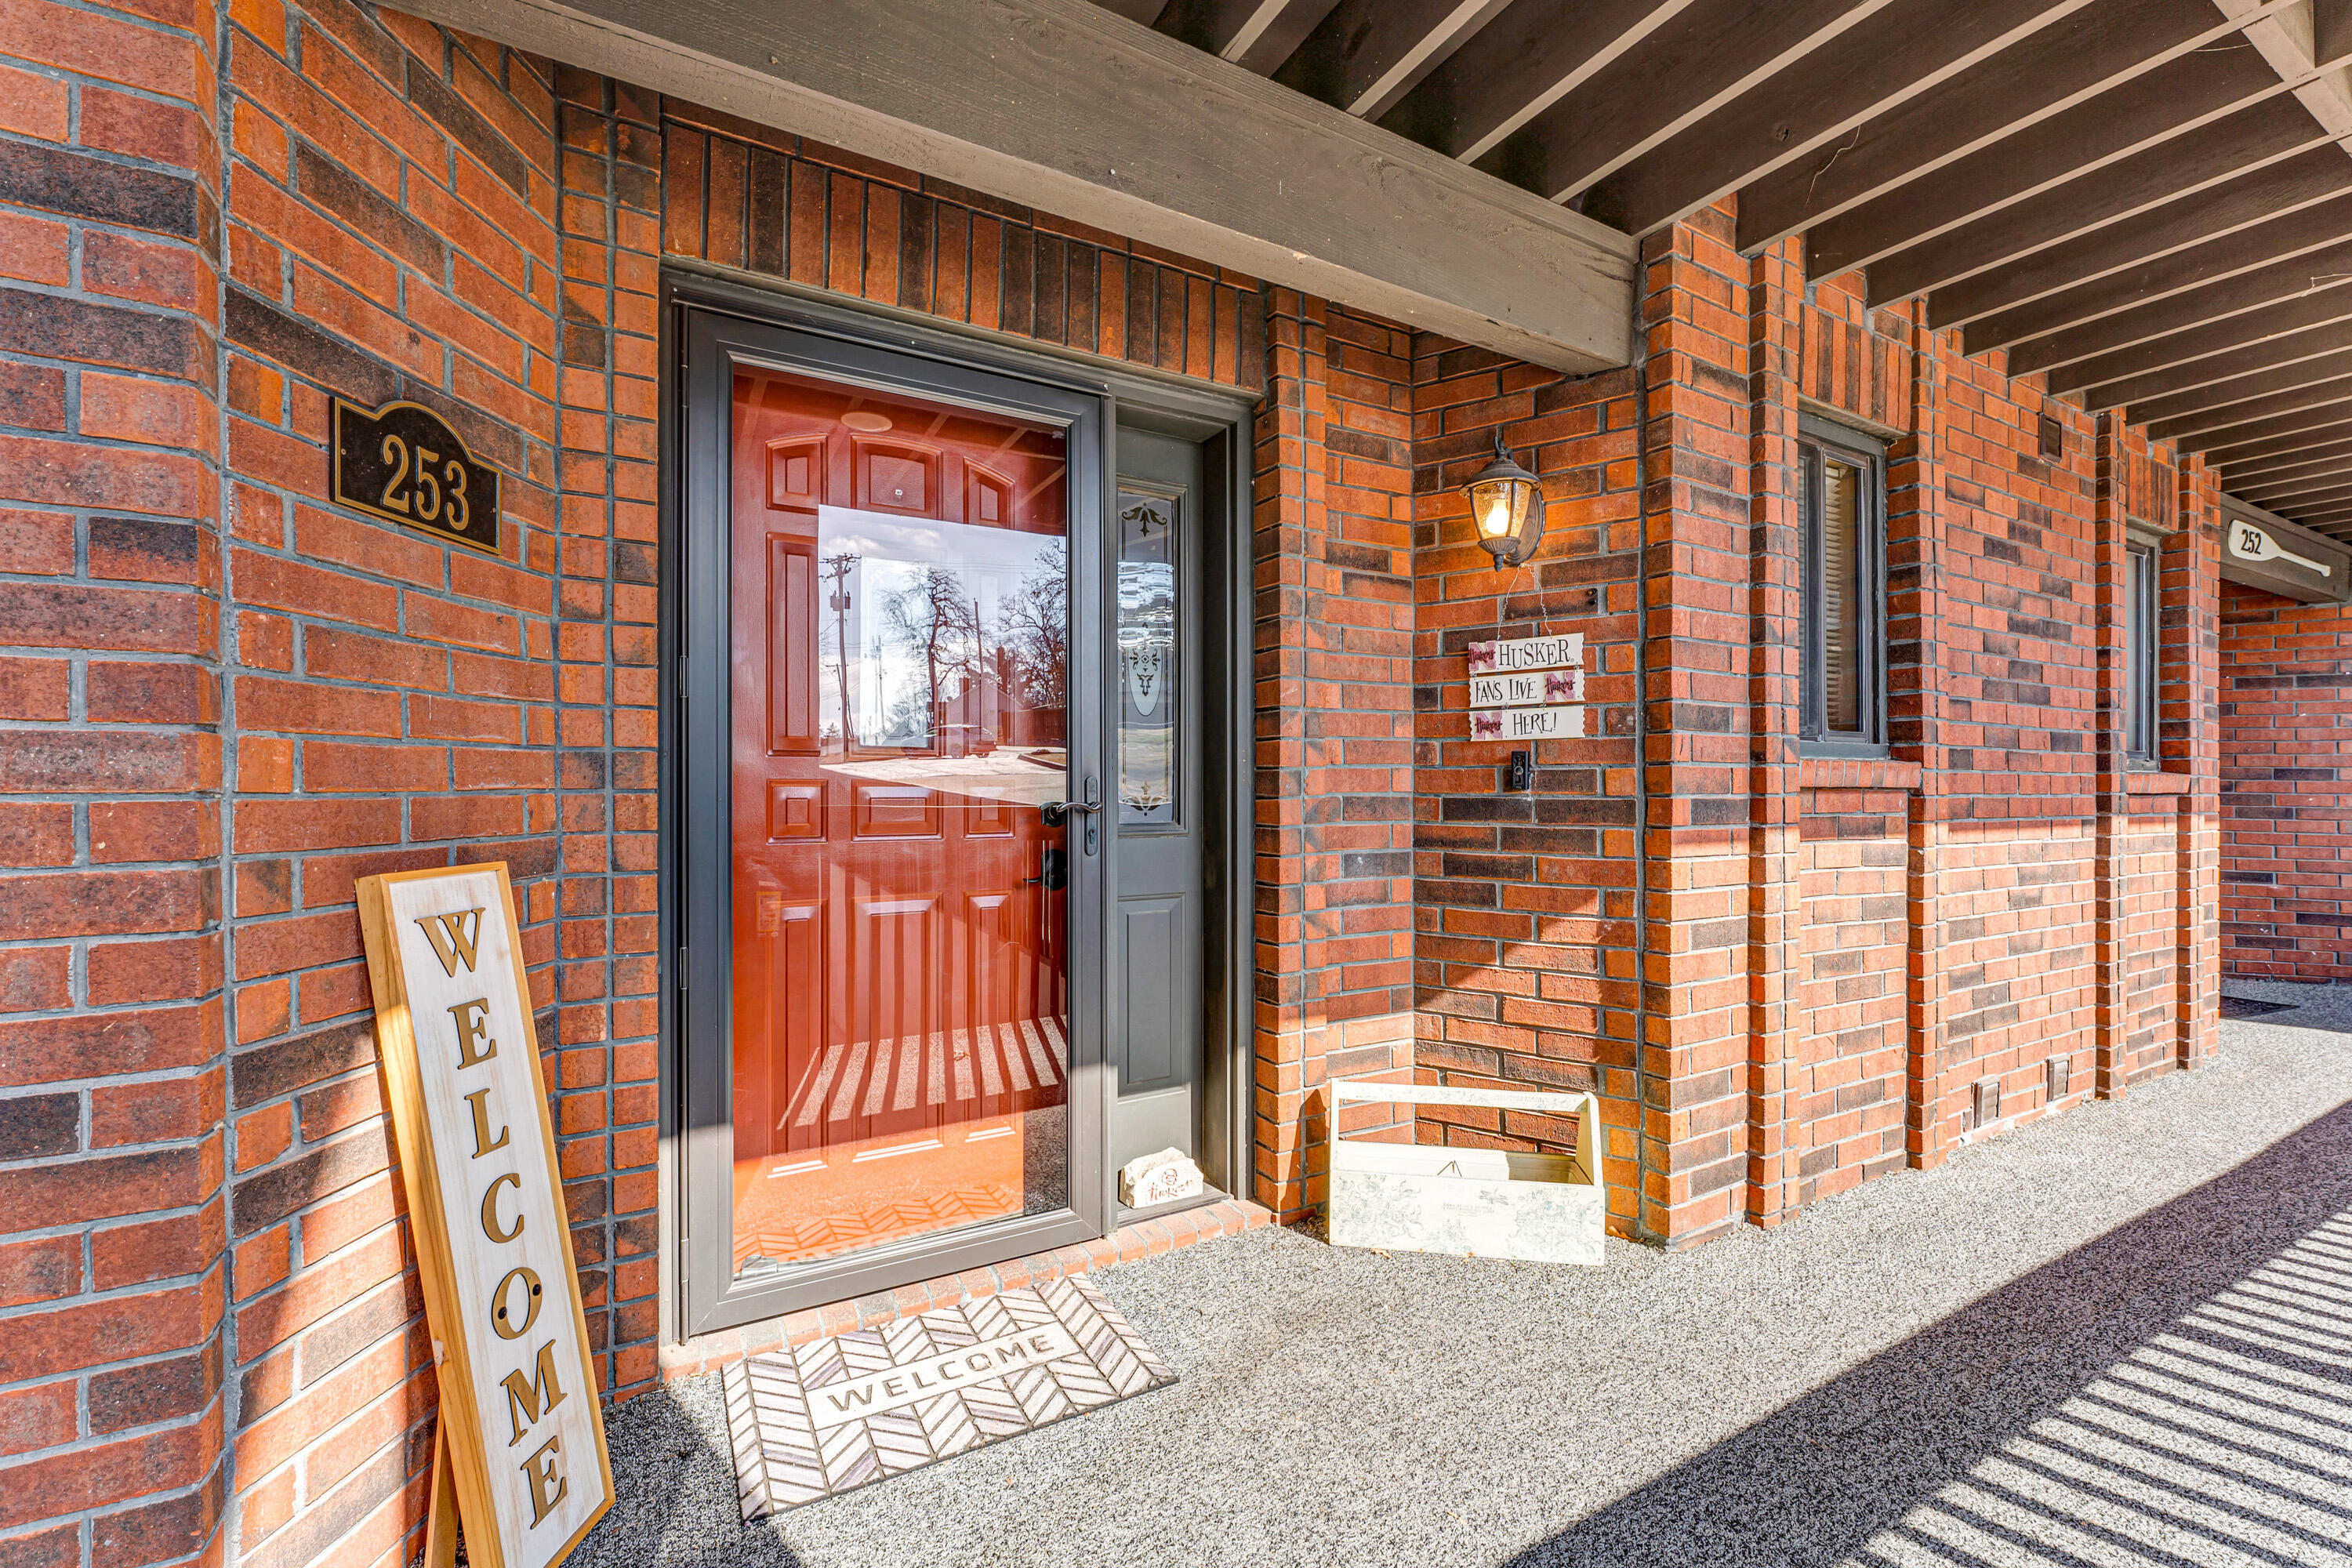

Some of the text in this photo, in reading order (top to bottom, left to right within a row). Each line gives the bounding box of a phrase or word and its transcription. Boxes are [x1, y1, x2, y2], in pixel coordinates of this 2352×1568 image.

[381, 434, 469, 530] 253
[2241, 528, 2262, 555] 252
[1498, 639, 1570, 669] HUSKER
[1475, 677, 1537, 703] FANS LIVE
[1513, 712, 1556, 735] HERE!
[413, 907, 568, 1531] WELCOME
[827, 1333, 1054, 1412] WELCOME
